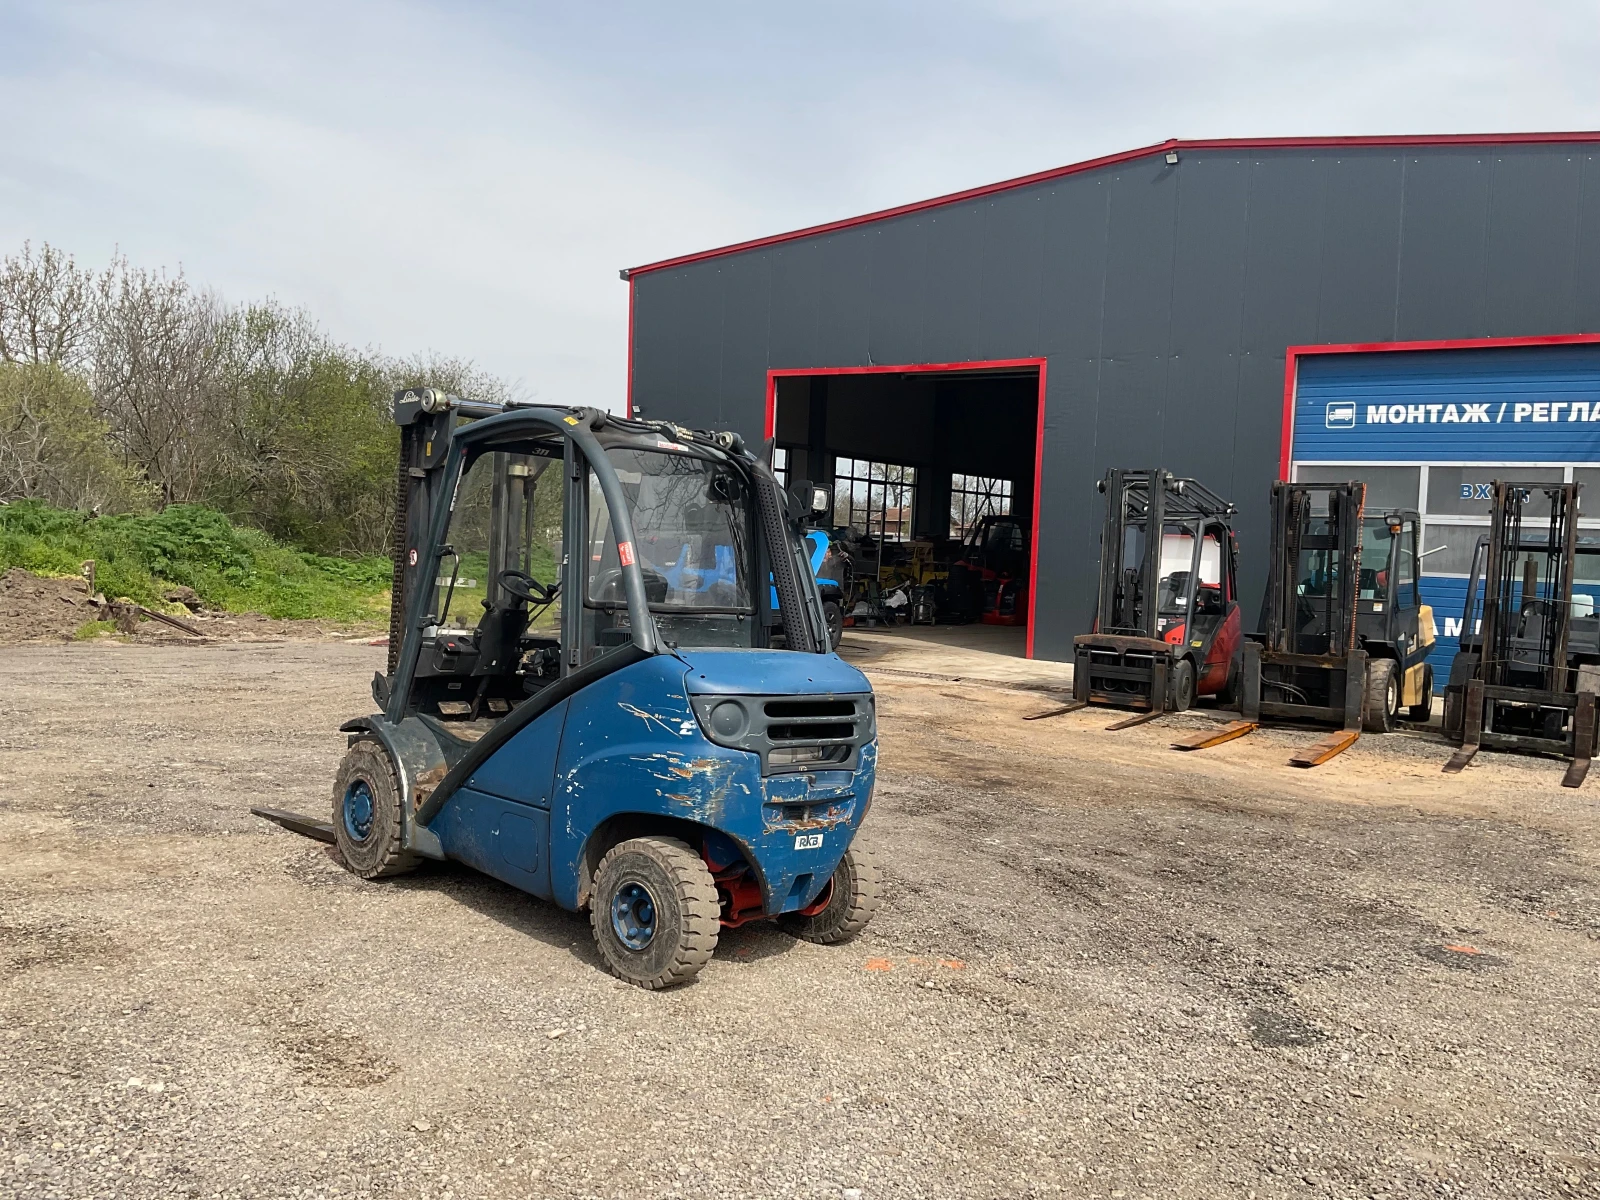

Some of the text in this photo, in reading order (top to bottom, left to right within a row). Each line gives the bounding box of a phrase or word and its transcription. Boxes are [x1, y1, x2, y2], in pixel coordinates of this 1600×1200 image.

[1366, 403, 1491, 424] МОНТАЖ
[1496, 402, 1507, 424] /
[799, 835, 818, 847] RKB
